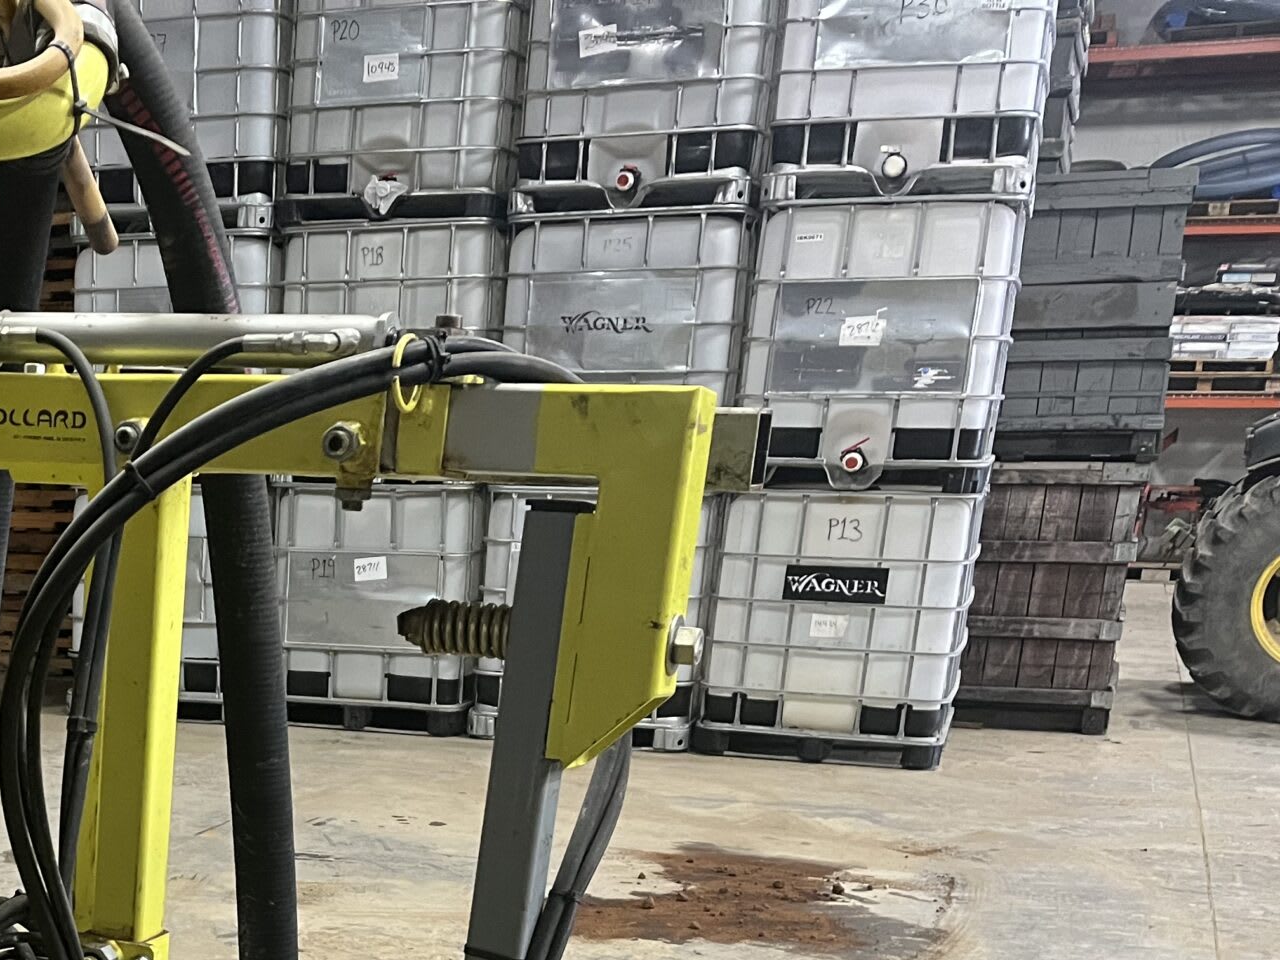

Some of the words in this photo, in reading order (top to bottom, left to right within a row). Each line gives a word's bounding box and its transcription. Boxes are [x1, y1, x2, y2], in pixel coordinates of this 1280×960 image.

[330, 19, 360, 43] P20
[805, 297, 836, 315] P22
[560, 310, 654, 335] WAGNER
[827, 516, 863, 543] P13
[310, 557, 336, 580] P19
[786, 572, 886, 598] WAGNER
